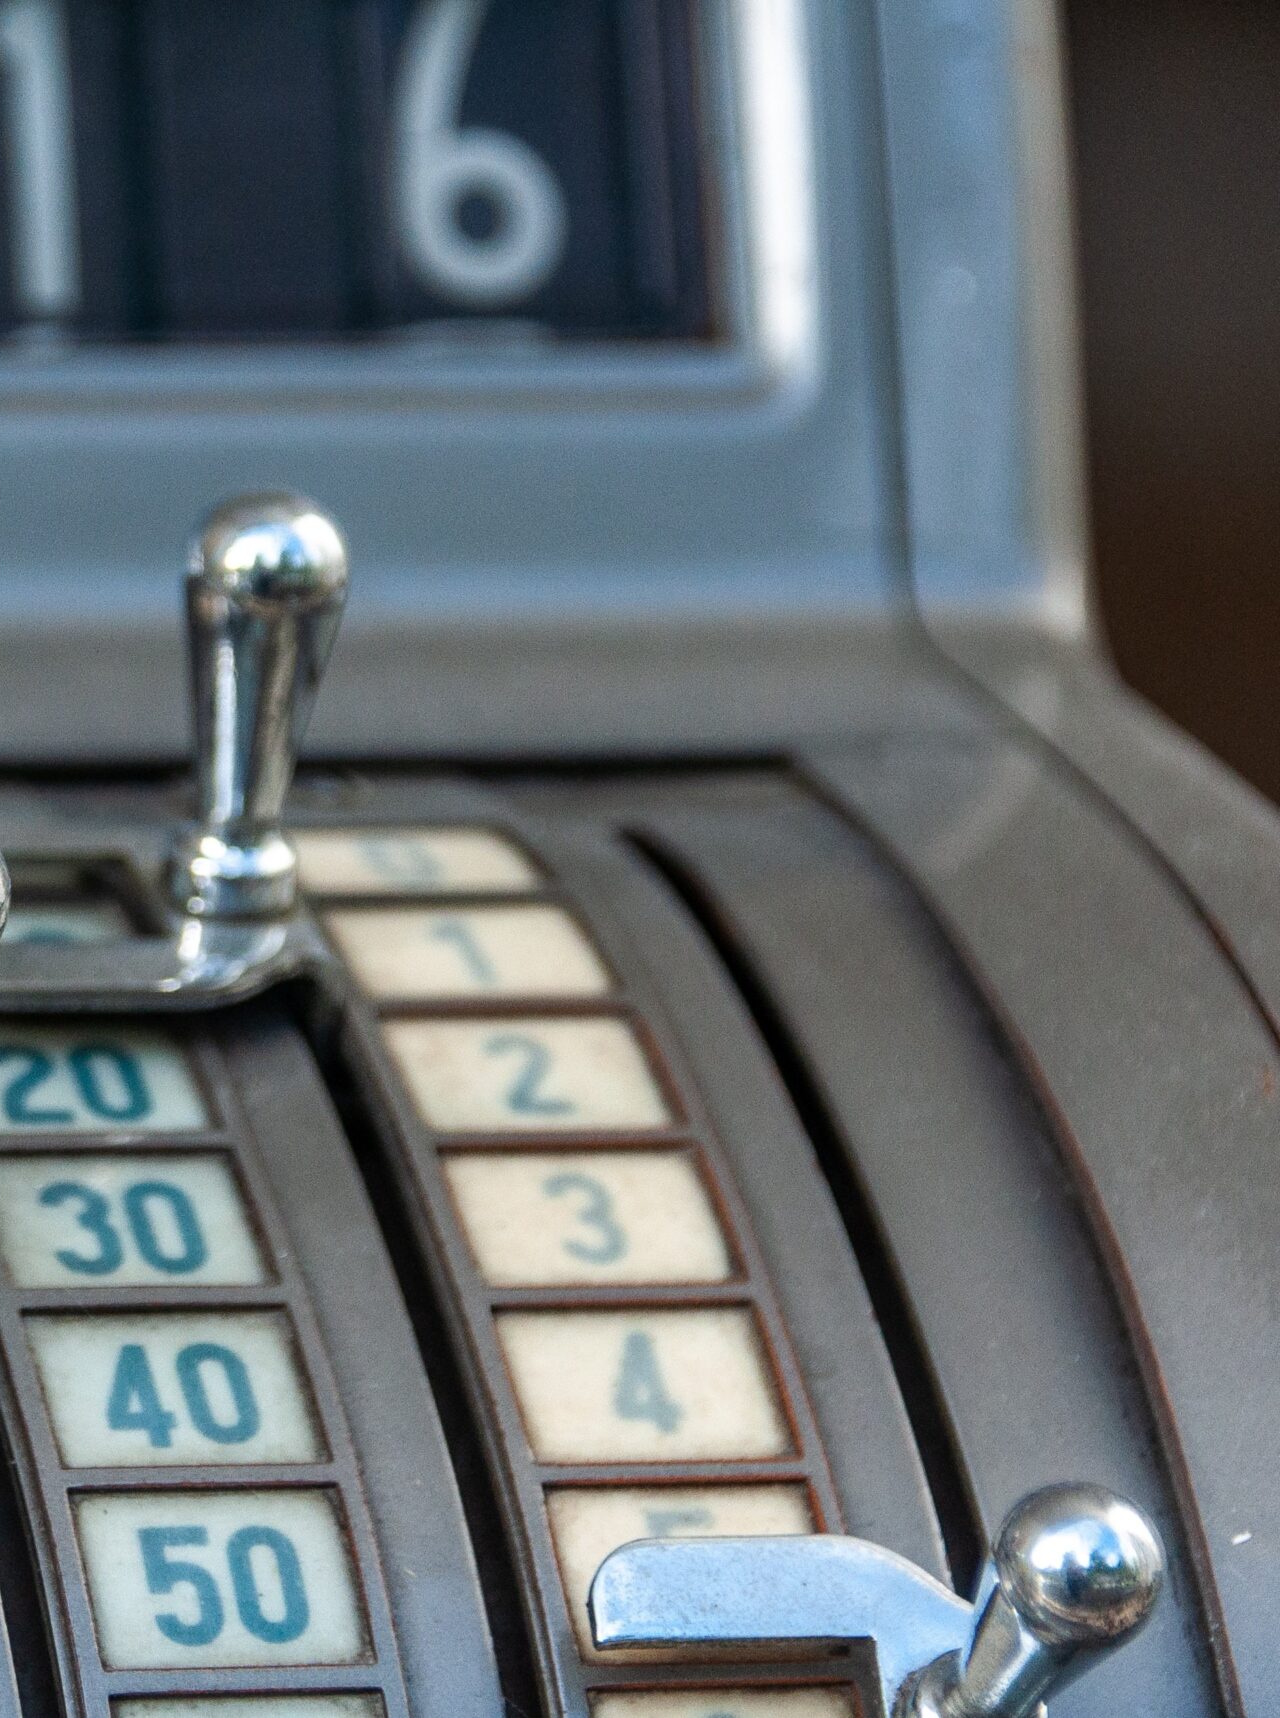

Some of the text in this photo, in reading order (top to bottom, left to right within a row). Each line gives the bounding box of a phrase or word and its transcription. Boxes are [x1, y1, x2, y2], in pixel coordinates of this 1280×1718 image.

[430, 918, 498, 983] 1
[483, 1033, 575, 1116] 2
[37, 1179, 209, 1276] 30
[540, 1172, 630, 1265] 3
[106, 1342, 261, 1449] 40
[610, 1330, 685, 1435] 4
[136, 1525, 310, 1647] 50
